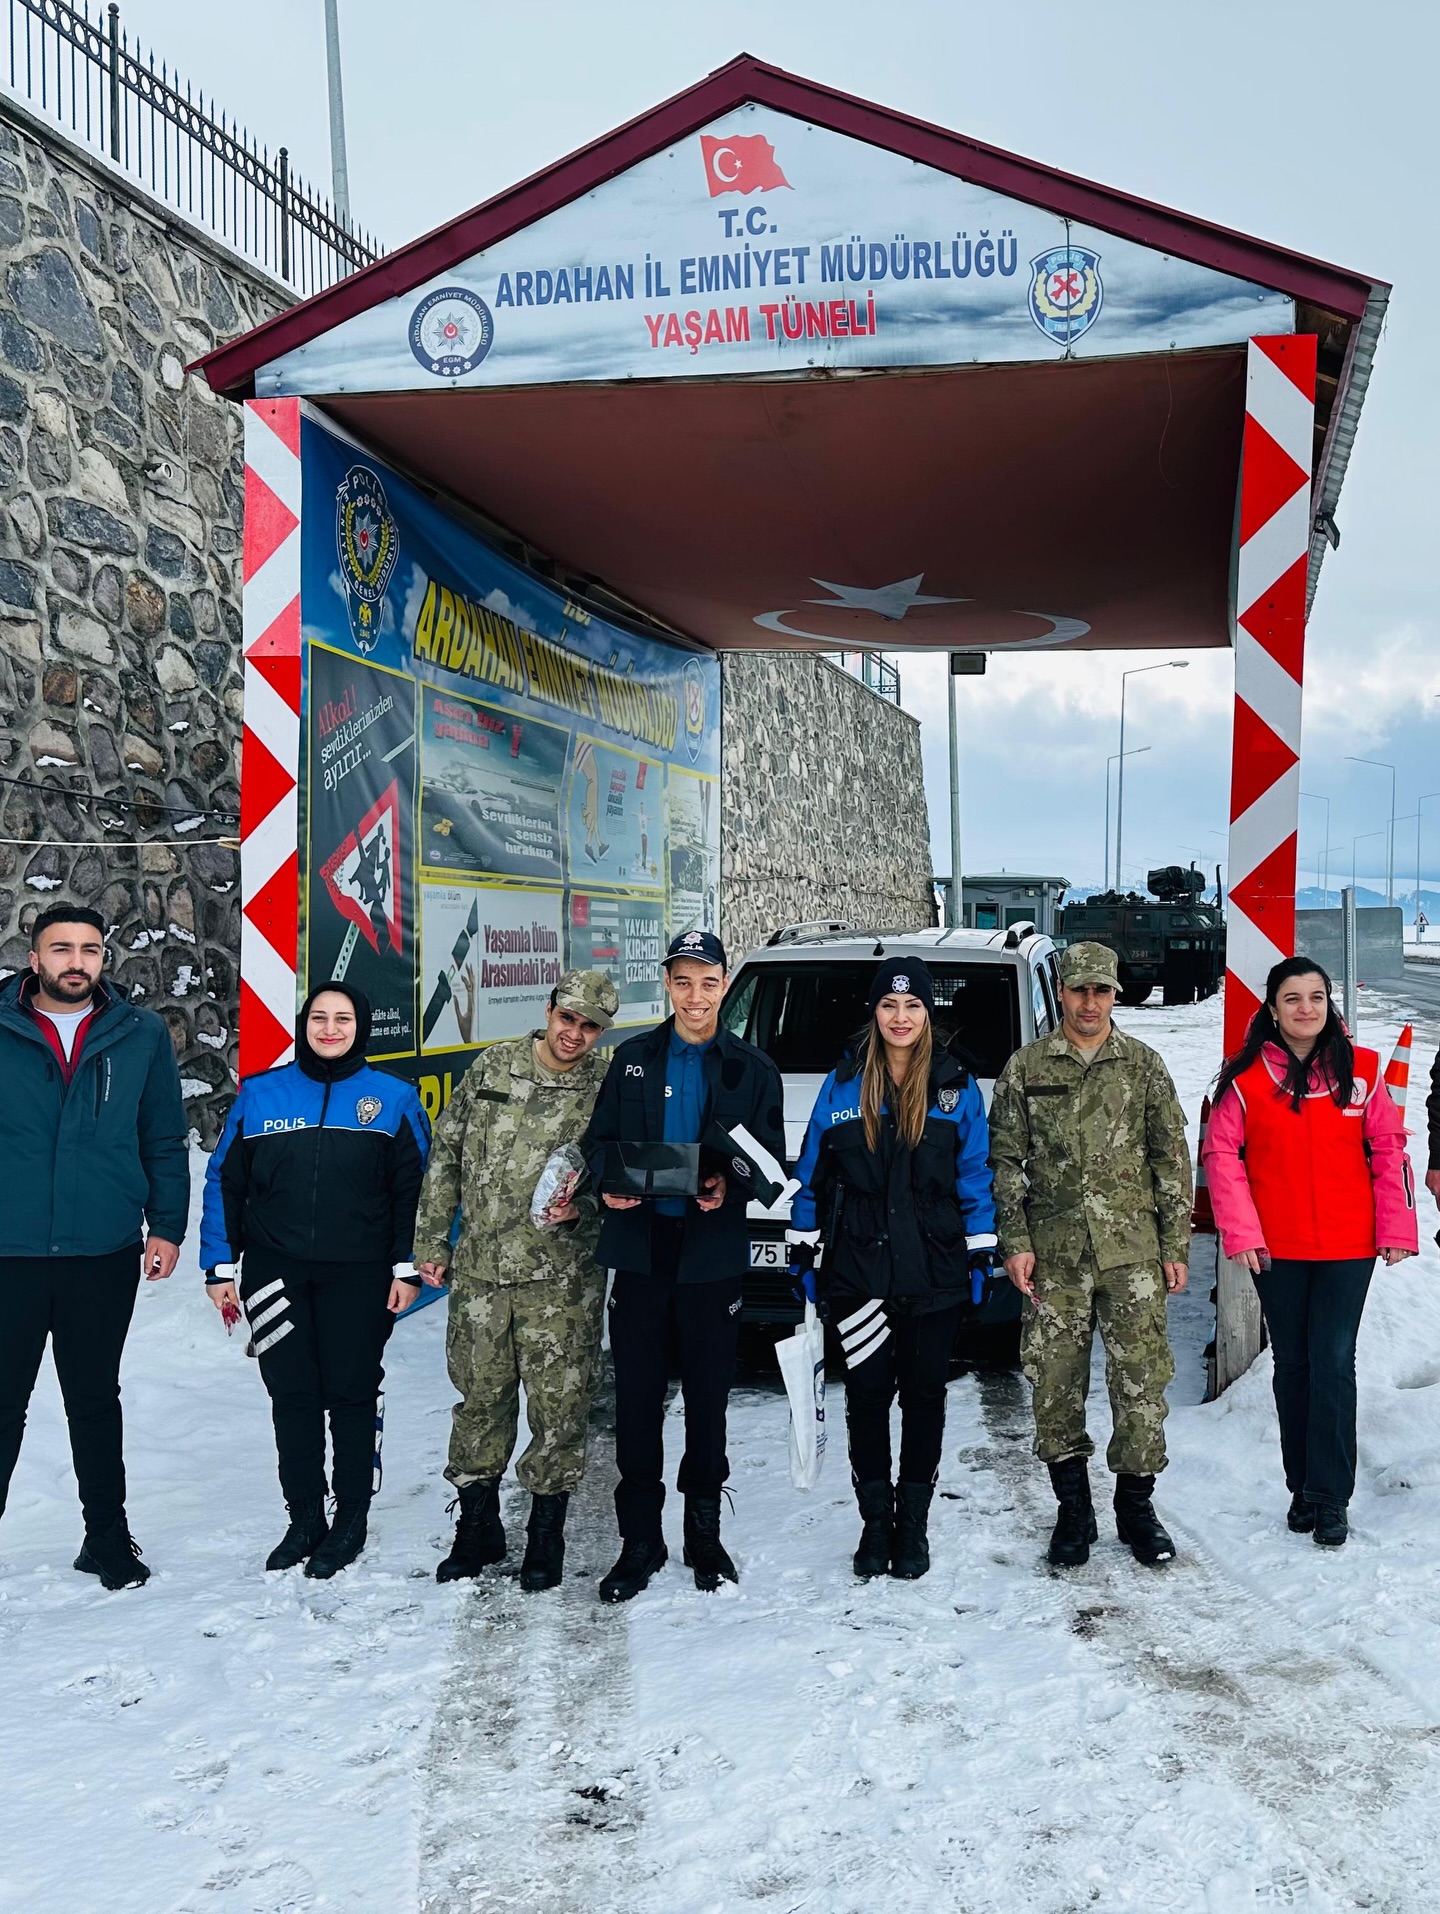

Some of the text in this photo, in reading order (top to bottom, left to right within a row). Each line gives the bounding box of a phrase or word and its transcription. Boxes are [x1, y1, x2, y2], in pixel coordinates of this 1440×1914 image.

[718, 206, 778, 238] T.C.
[495, 229, 1017, 308] ARDAHAN İL EMNİYET MÜDÜRLÜĞÜ
[414, 305, 428, 347] ARDAHAN
[428, 291, 463, 306] EMNİYET
[643, 289, 877, 355] YAŞAM TÜNELİ
[413, 579, 524, 697] ARDAHAN
[519, 628, 597, 723] EMNİYET
[321, 695, 393, 764] sevdiklerimizden
[481, 809, 553, 831] sevdiklerini
[515, 829, 553, 844] sensiz
[484, 921, 558, 959] Yaşamla Ölüm
[625, 918, 659, 937] YAYALAR
[625, 938, 659, 961] KIRMIZI
[481, 958, 561, 988] Arasındaki Fark
[263, 1117, 306, 1132] POLİS
[831, 1105, 862, 1124] POLİ
[752, 1243, 777, 1264] 75
